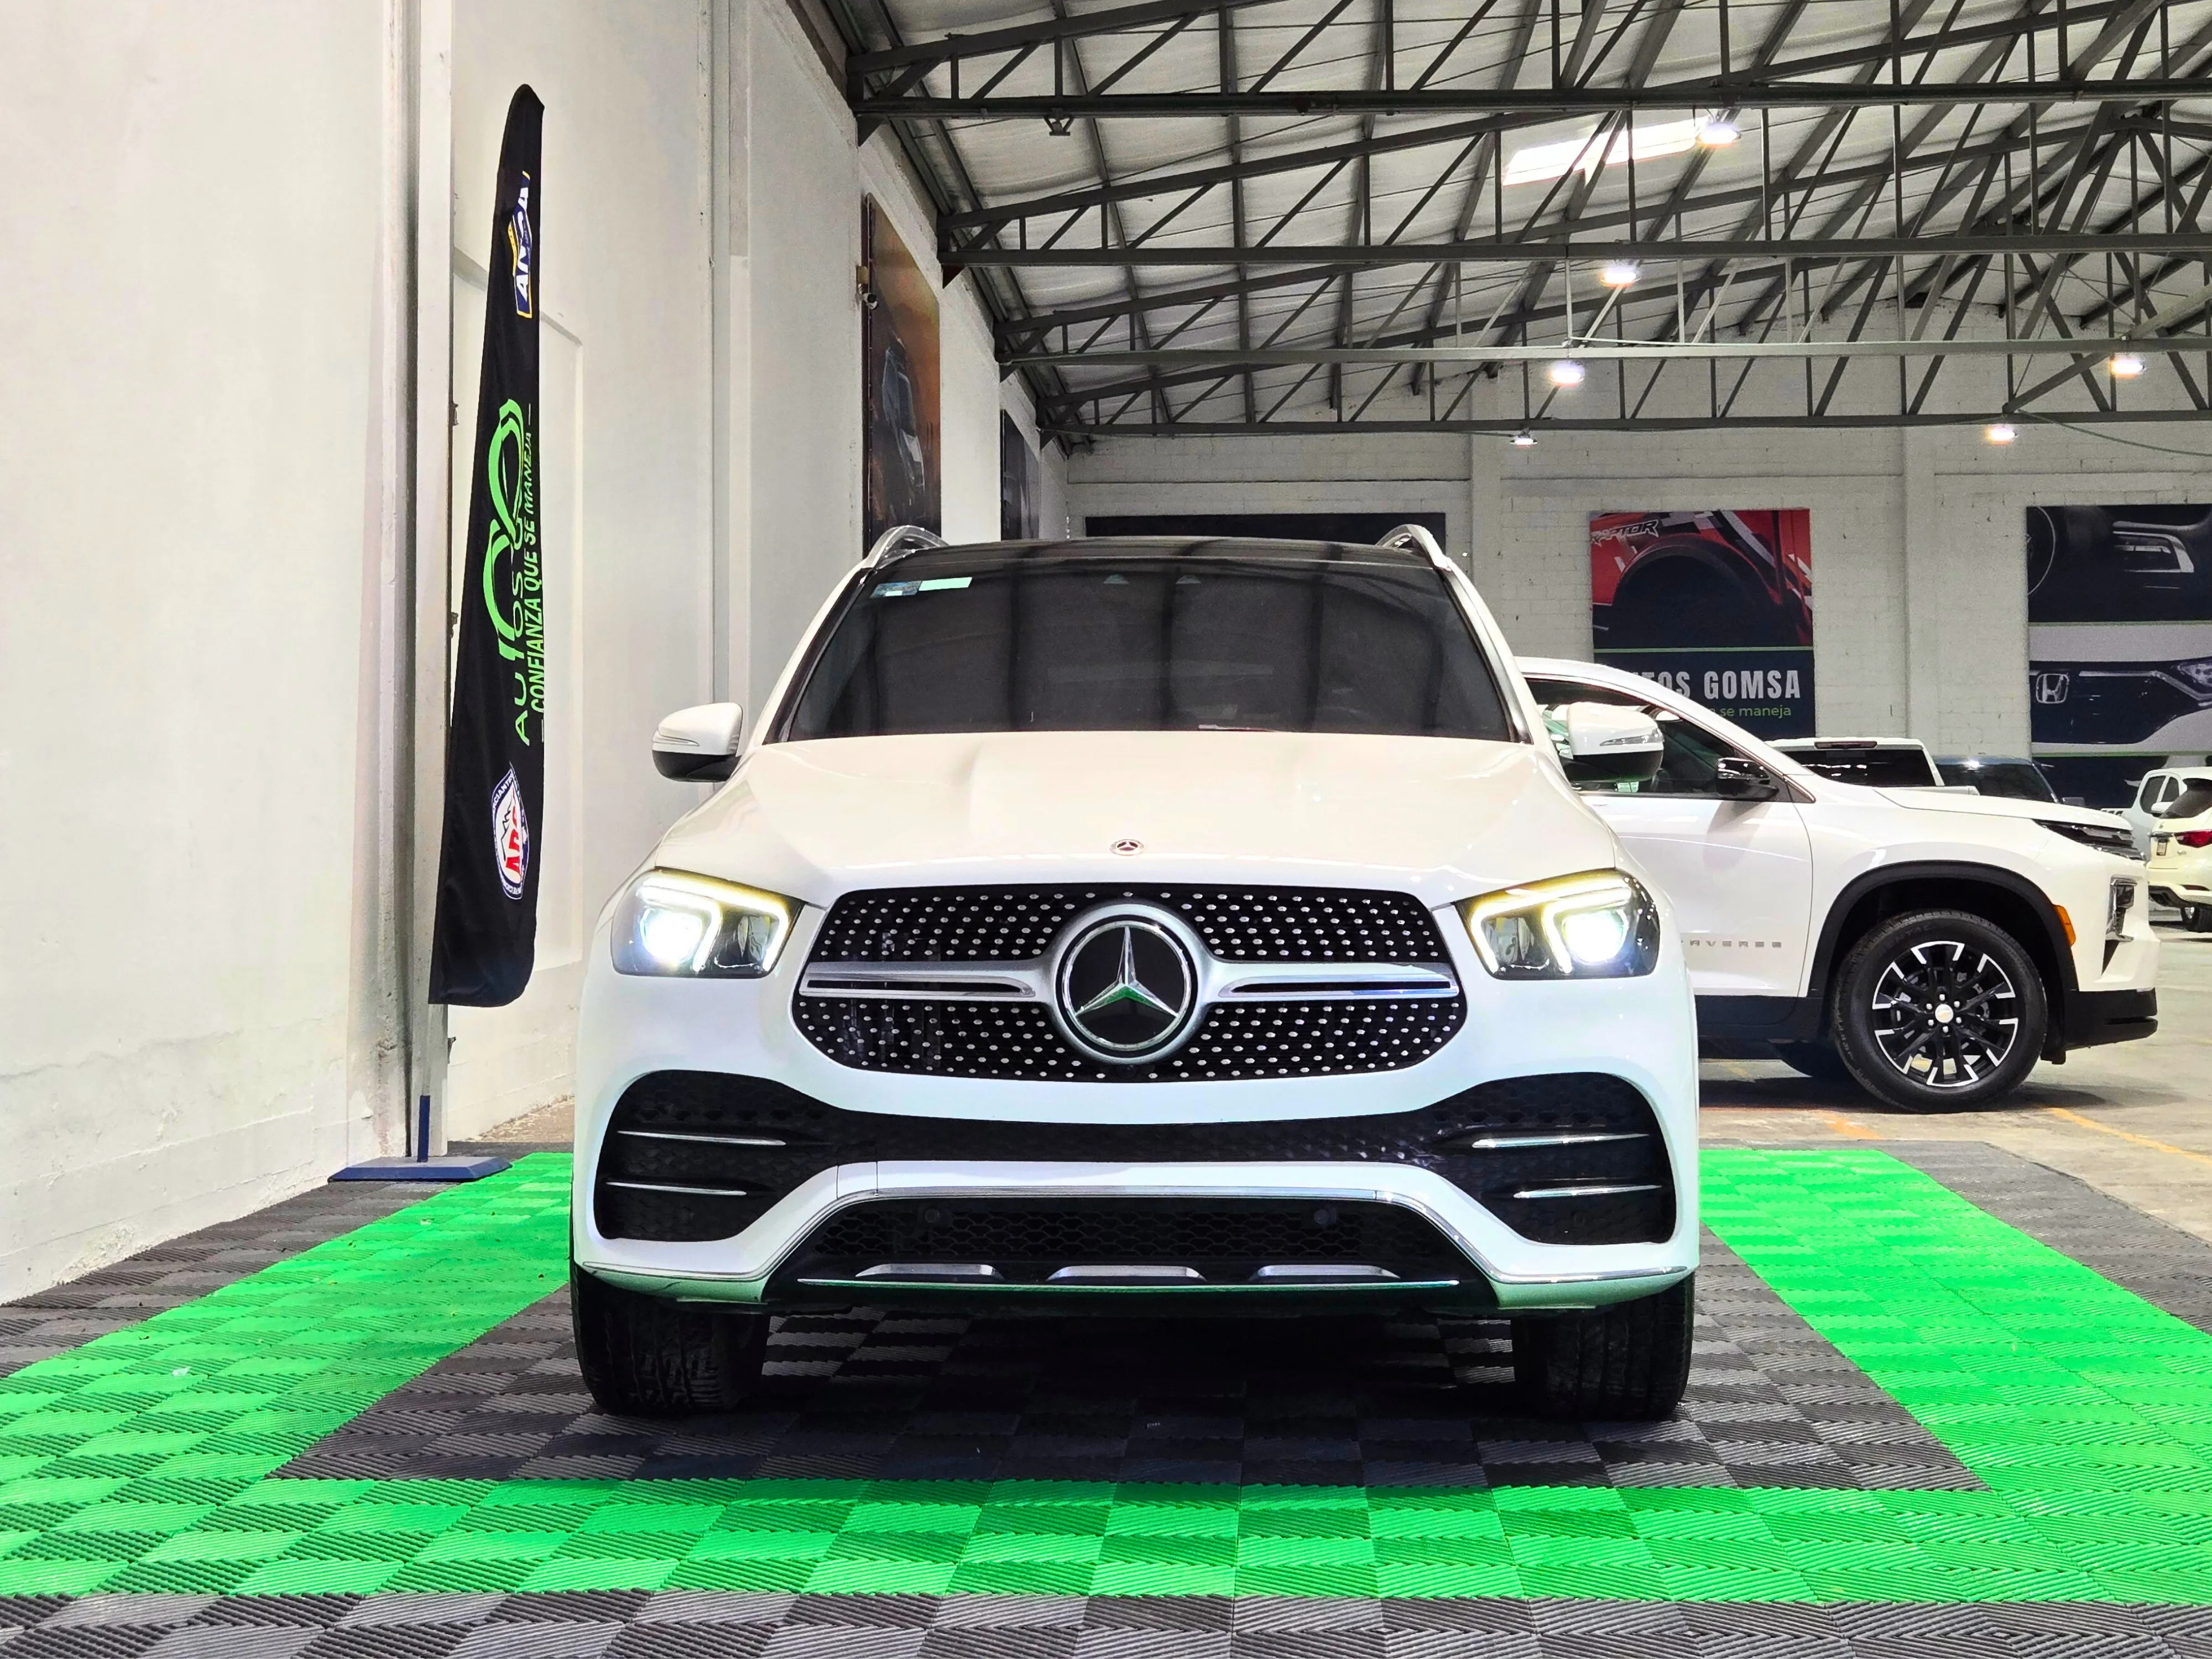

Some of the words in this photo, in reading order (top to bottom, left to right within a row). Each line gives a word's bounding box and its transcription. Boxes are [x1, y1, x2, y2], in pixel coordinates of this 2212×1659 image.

[523, 432, 534, 514] MANEJA
[524, 517, 536, 546] SE
[524, 548, 542, 591] QUE
[524, 598, 544, 713] CONFIANZA
[1704, 670, 1801, 700] GOMSA
[1739, 705, 1791, 718] maneja
